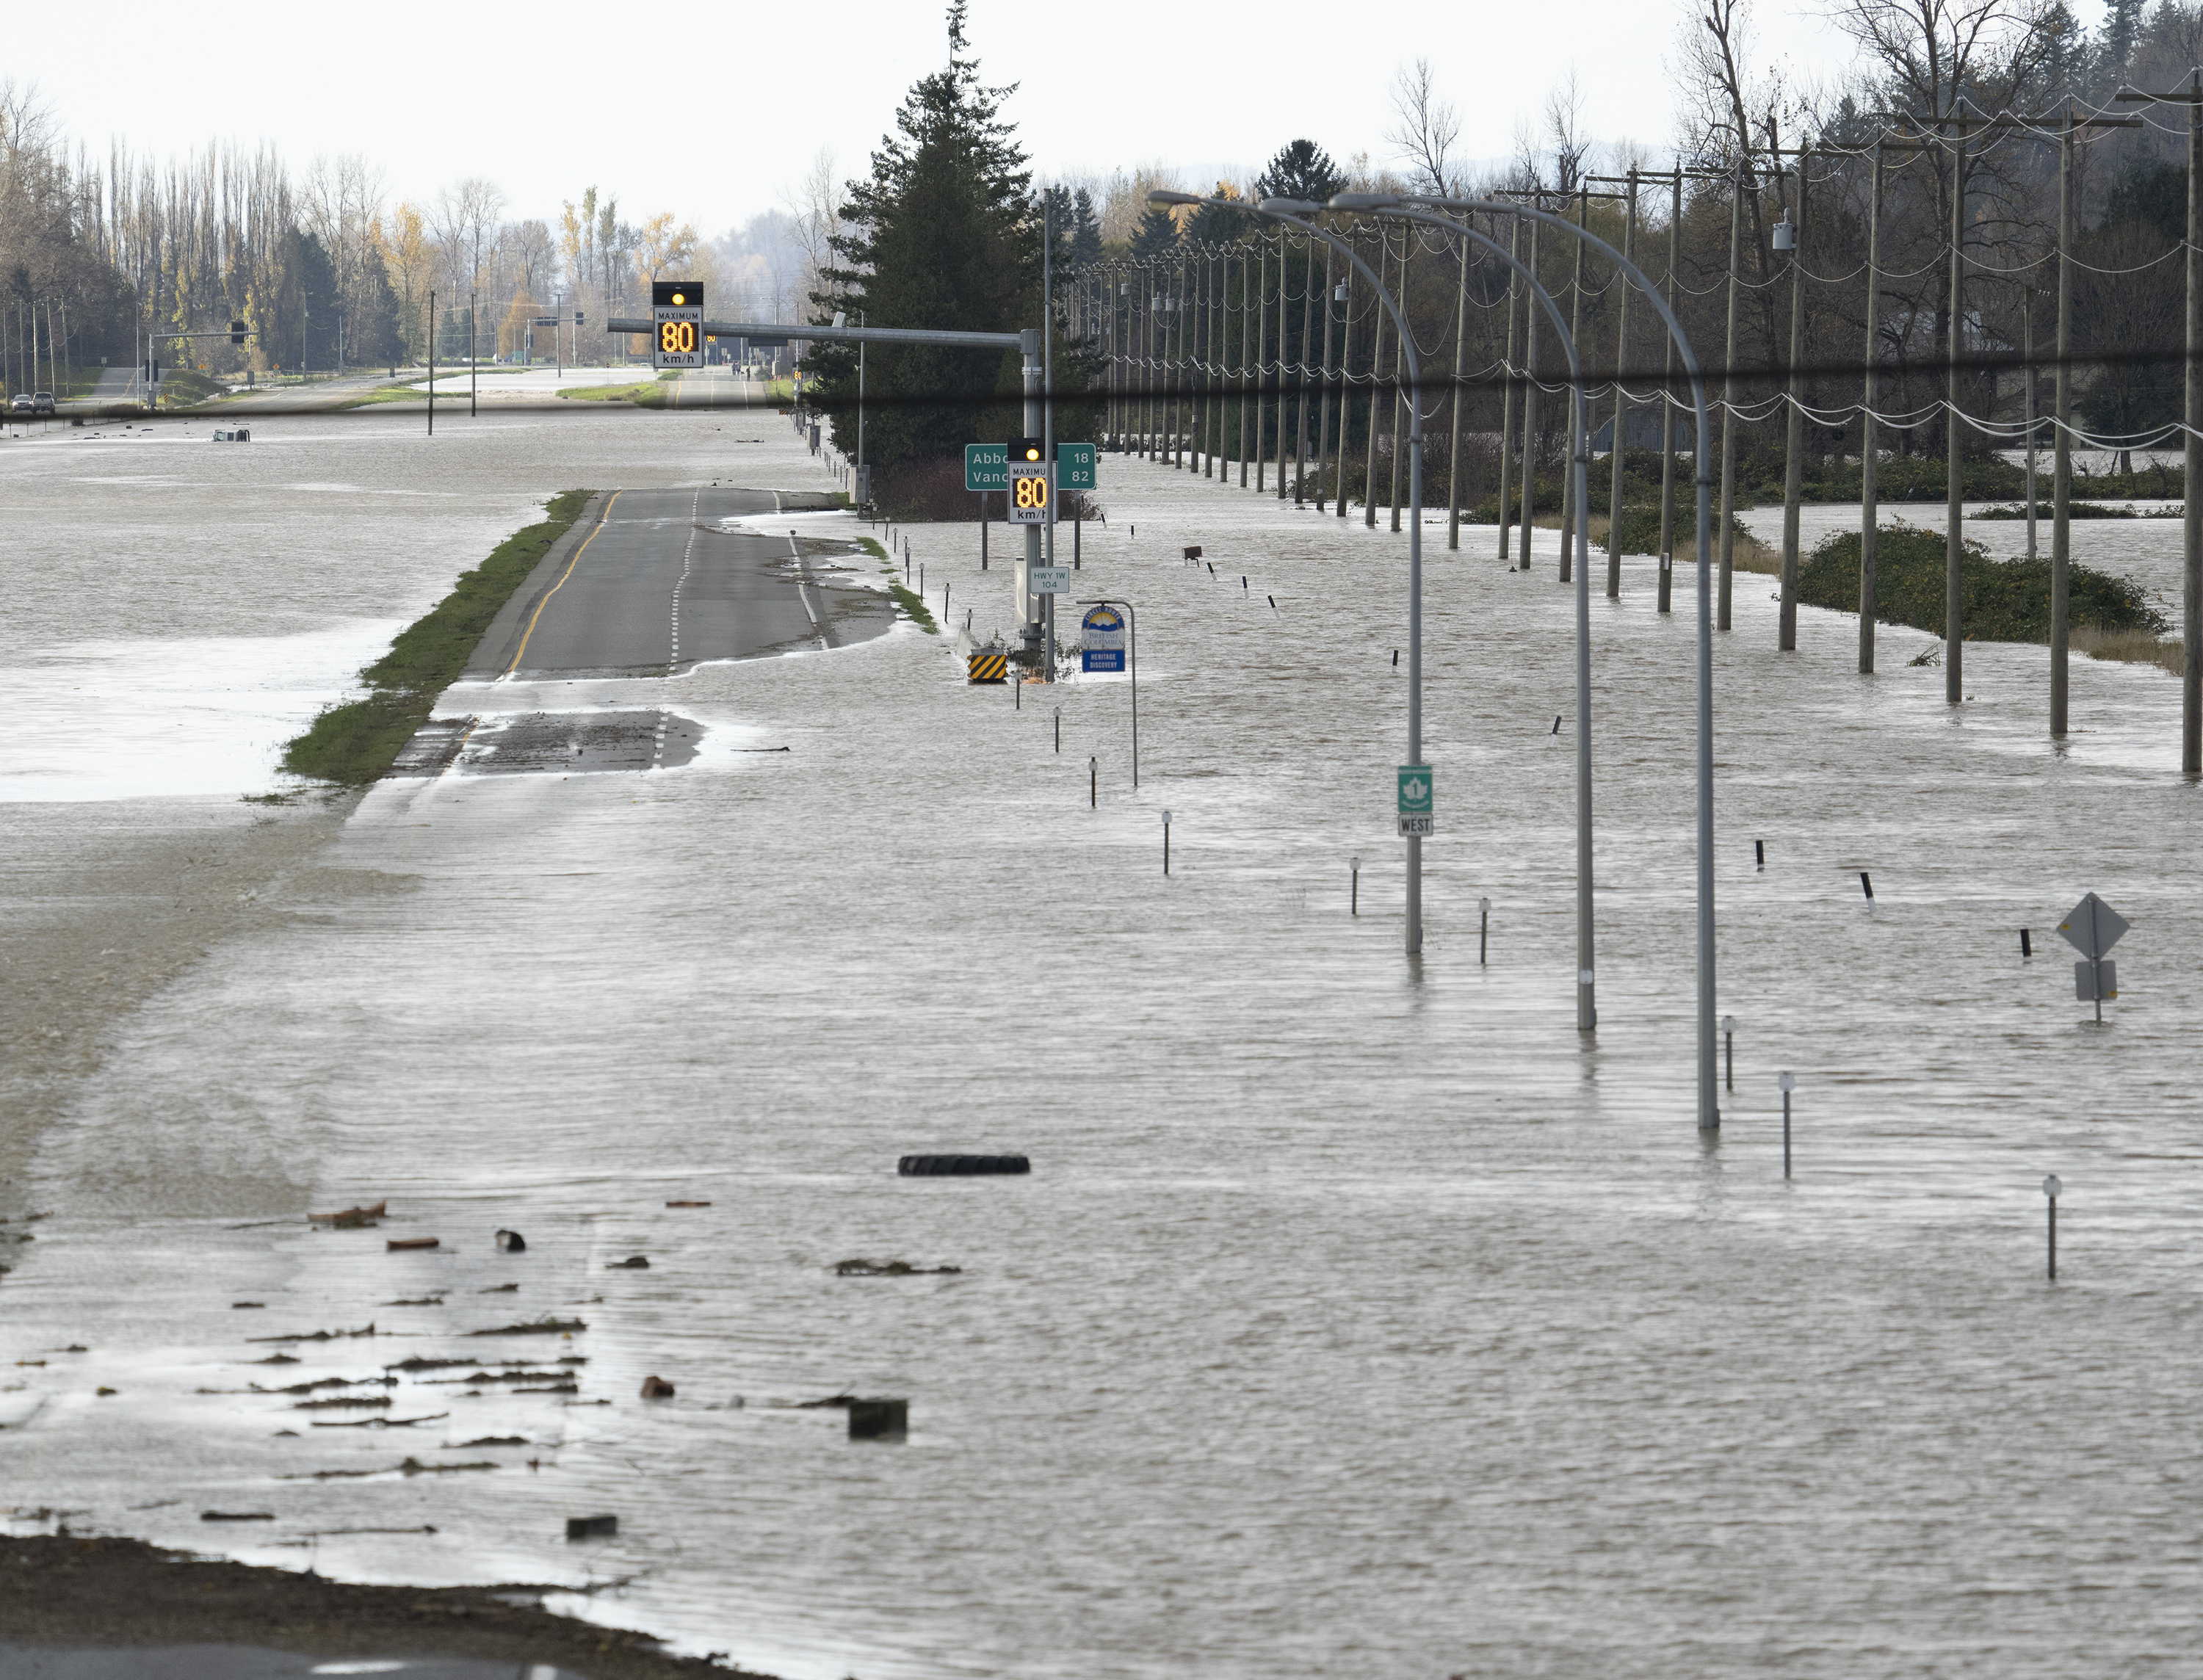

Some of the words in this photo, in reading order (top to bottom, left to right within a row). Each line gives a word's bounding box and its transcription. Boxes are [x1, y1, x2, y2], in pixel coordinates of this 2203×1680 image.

[658, 312, 698, 320] MAXIMUM
[662, 322, 693, 352] 80
[663, 354, 695, 363] km/h
[1074, 452, 1089, 463] 18
[1013, 468, 1046, 476] MAXIMU
[1072, 471, 1089, 482] 82
[1016, 477, 1047, 508] 80
[1085, 607, 1102, 621] CIRCLE
[1104, 607, 1121, 620] ROUTE
[1412, 783, 1418, 796] 1
[1401, 819, 1430, 832] WEST
